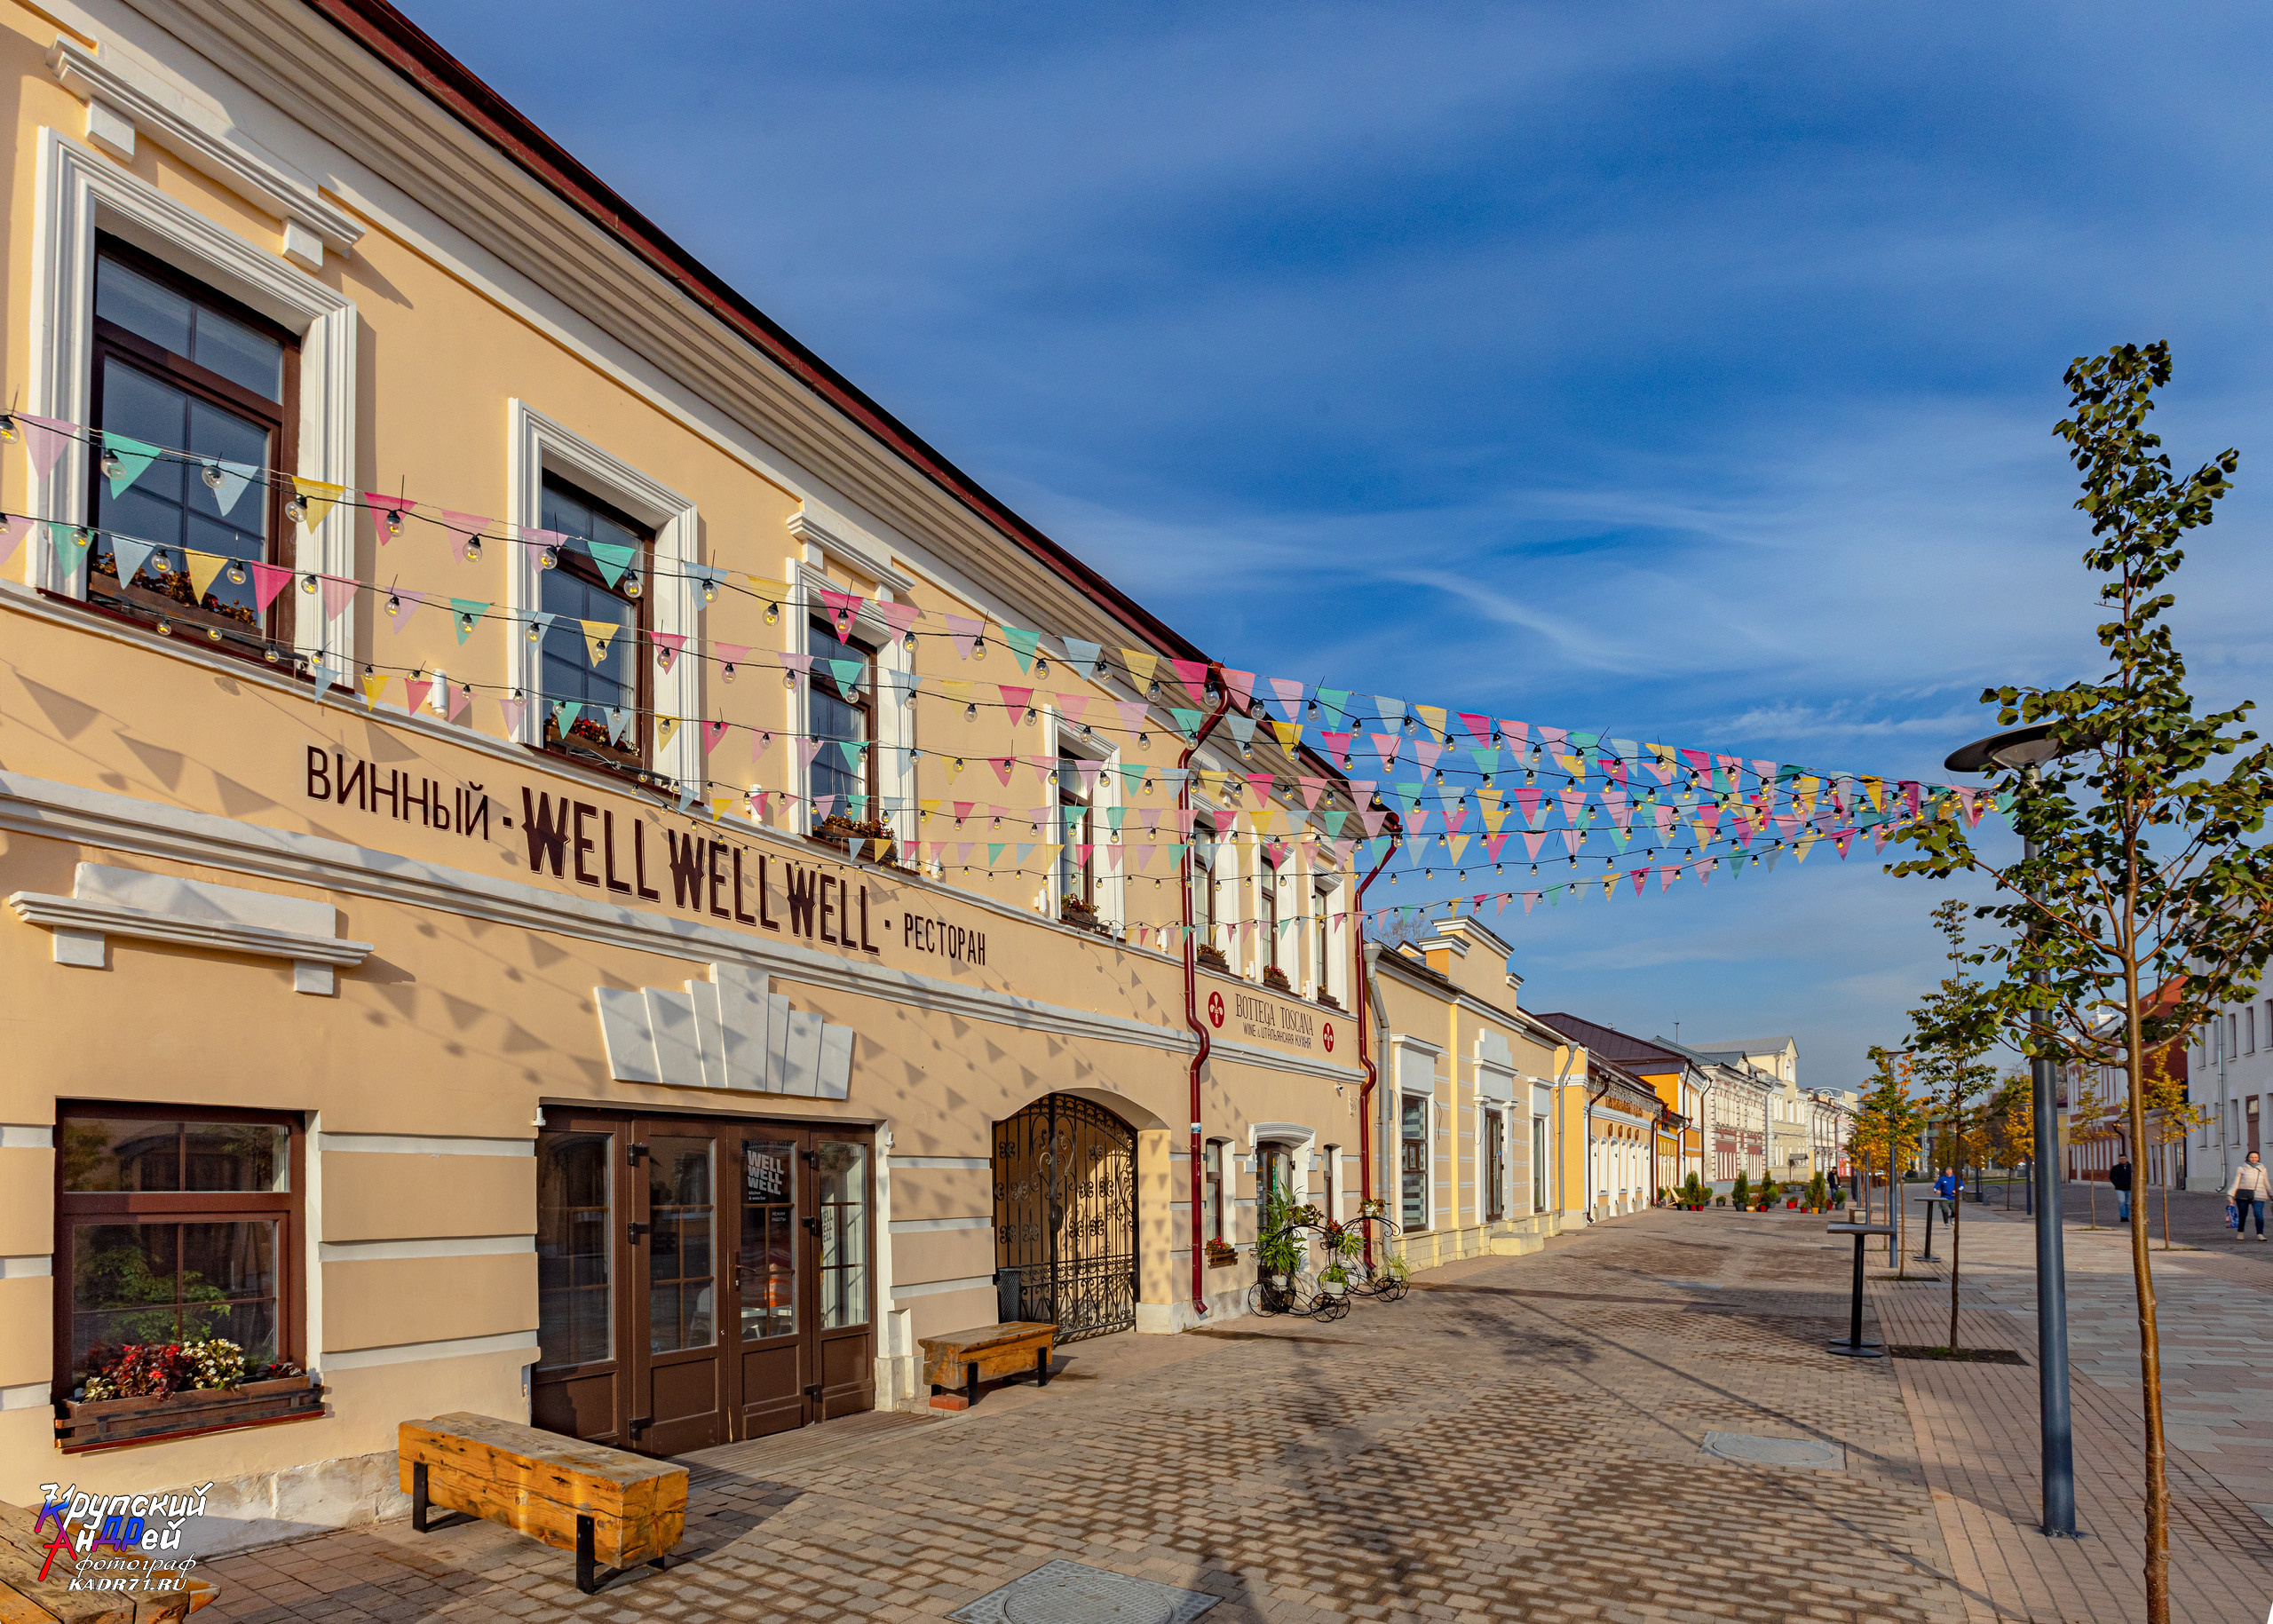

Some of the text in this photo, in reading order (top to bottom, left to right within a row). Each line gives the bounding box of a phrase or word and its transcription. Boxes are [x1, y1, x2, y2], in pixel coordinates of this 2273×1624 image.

[307, 745, 986, 966] ВИННЫЙ WELL WELL WELL РЕСТОРАН
[1235, 993, 1314, 1036] BOTTEGA TOSCANA
[1243, 1022, 1256, 1037] WINE
[1261, 1026, 1294, 1045] ИТАЛЬЯНСКАЯ
[1295, 1034, 1311, 1050] КУХНЯ
[748, 1150, 784, 1175] WELL
[748, 1165, 782, 1184] WELL
[748, 1176, 781, 1195] WELL
